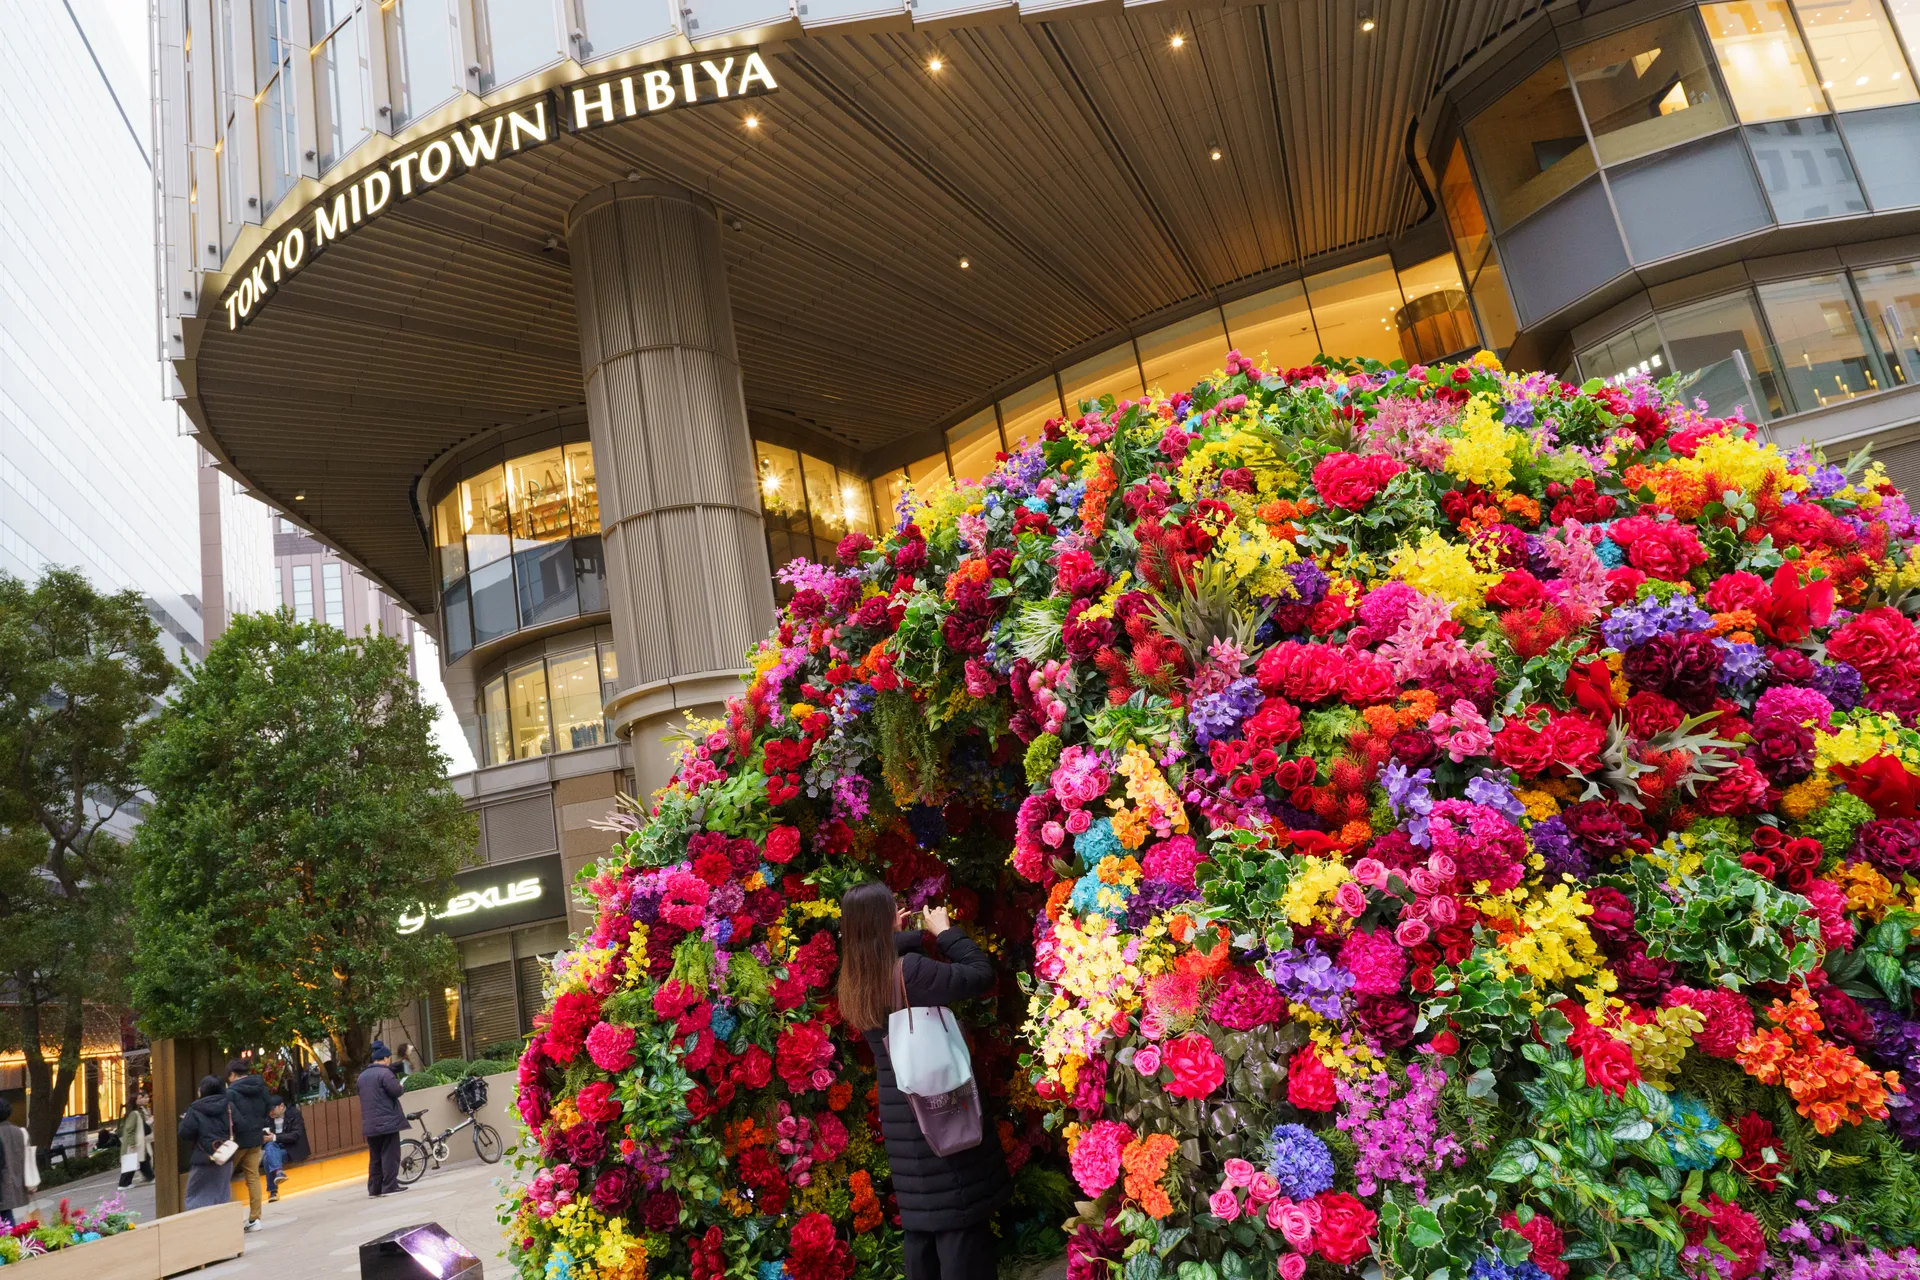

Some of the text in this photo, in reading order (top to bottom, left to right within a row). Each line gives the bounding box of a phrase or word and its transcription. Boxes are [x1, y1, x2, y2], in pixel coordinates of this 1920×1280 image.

[225, 52, 778, 331] TOKYO MIDTOWN HIBIYA
